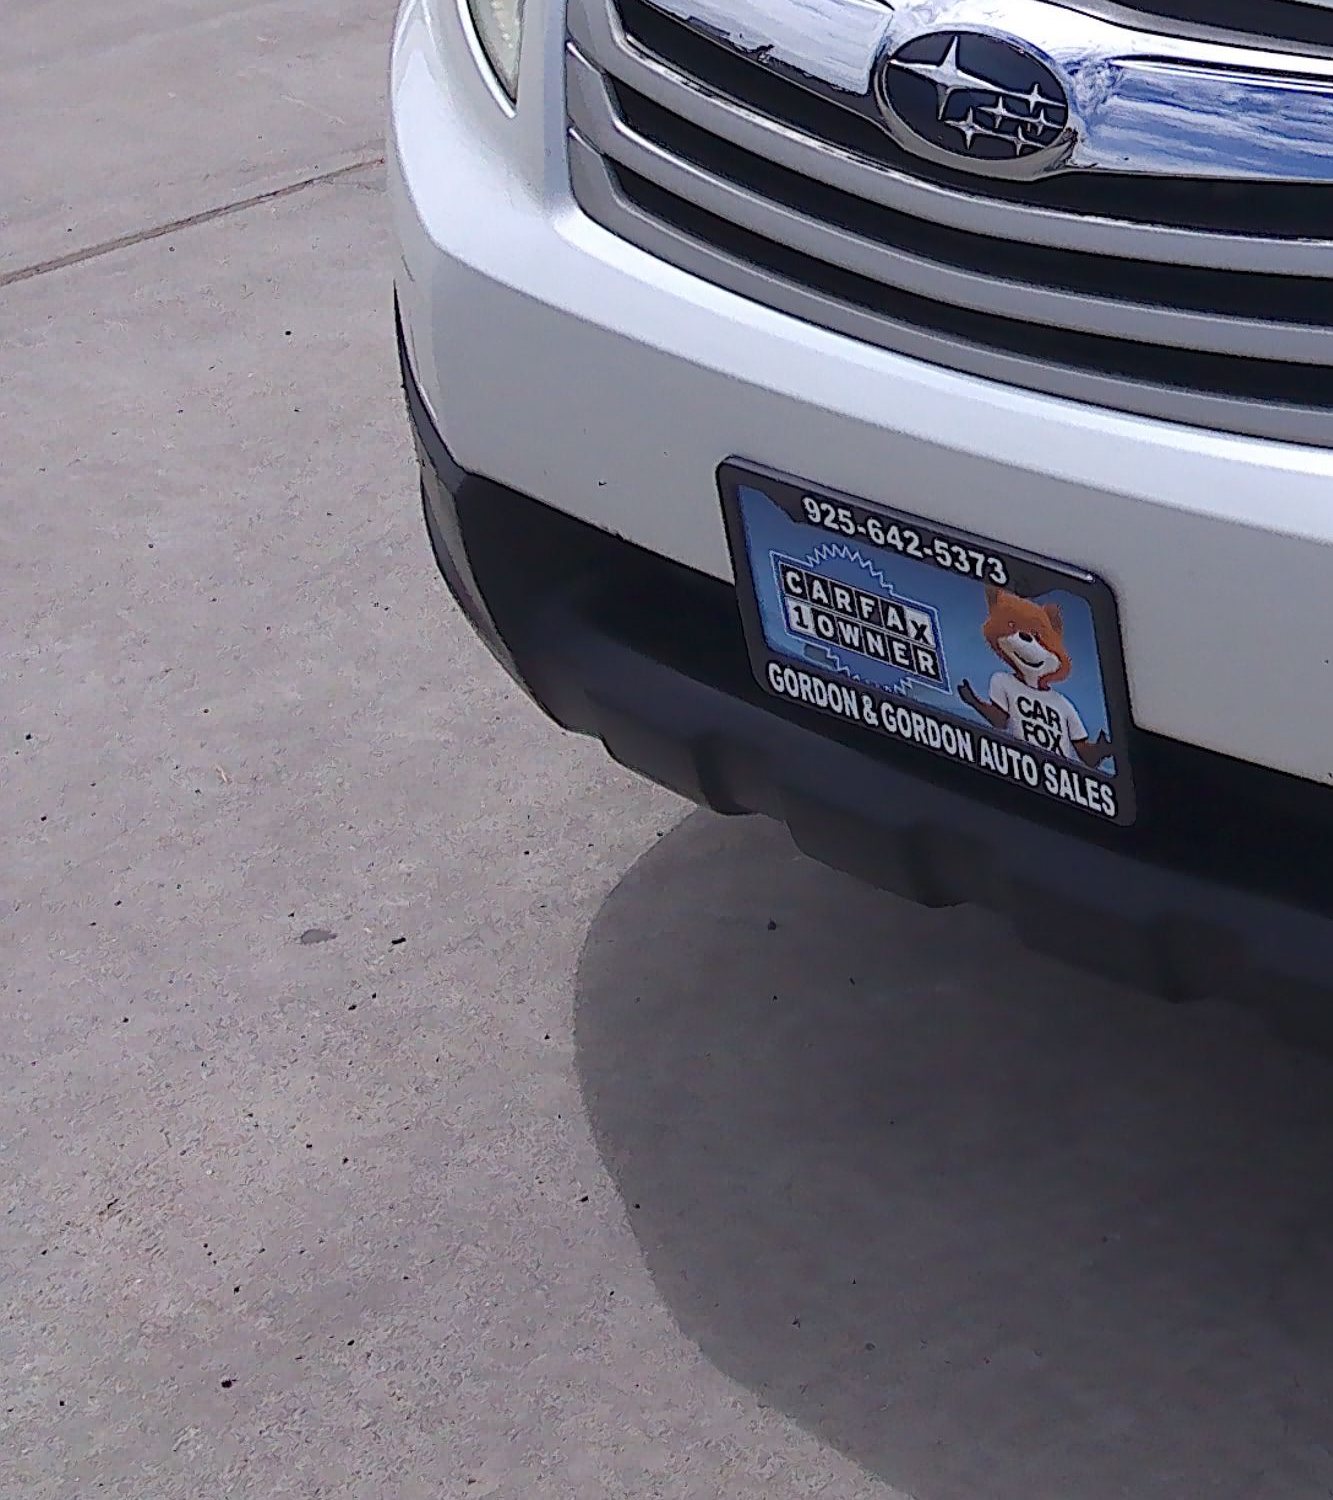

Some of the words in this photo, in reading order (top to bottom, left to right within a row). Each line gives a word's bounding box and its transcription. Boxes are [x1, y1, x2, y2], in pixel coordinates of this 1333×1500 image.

[803, 497, 1007, 585] 925-642-5373
[785, 568, 933, 646] CARFAX
[815, 618, 936, 676] OWNER
[767, 662, 861, 720] GORDON
[861, 694, 880, 727] &
[880, 702, 975, 762] GORDON
[979, 737, 1039, 787] AUTO
[1043, 762, 1117, 817] SALES
[1017, 696, 1063, 733] CAR
[1021, 719, 1067, 759] FOX
